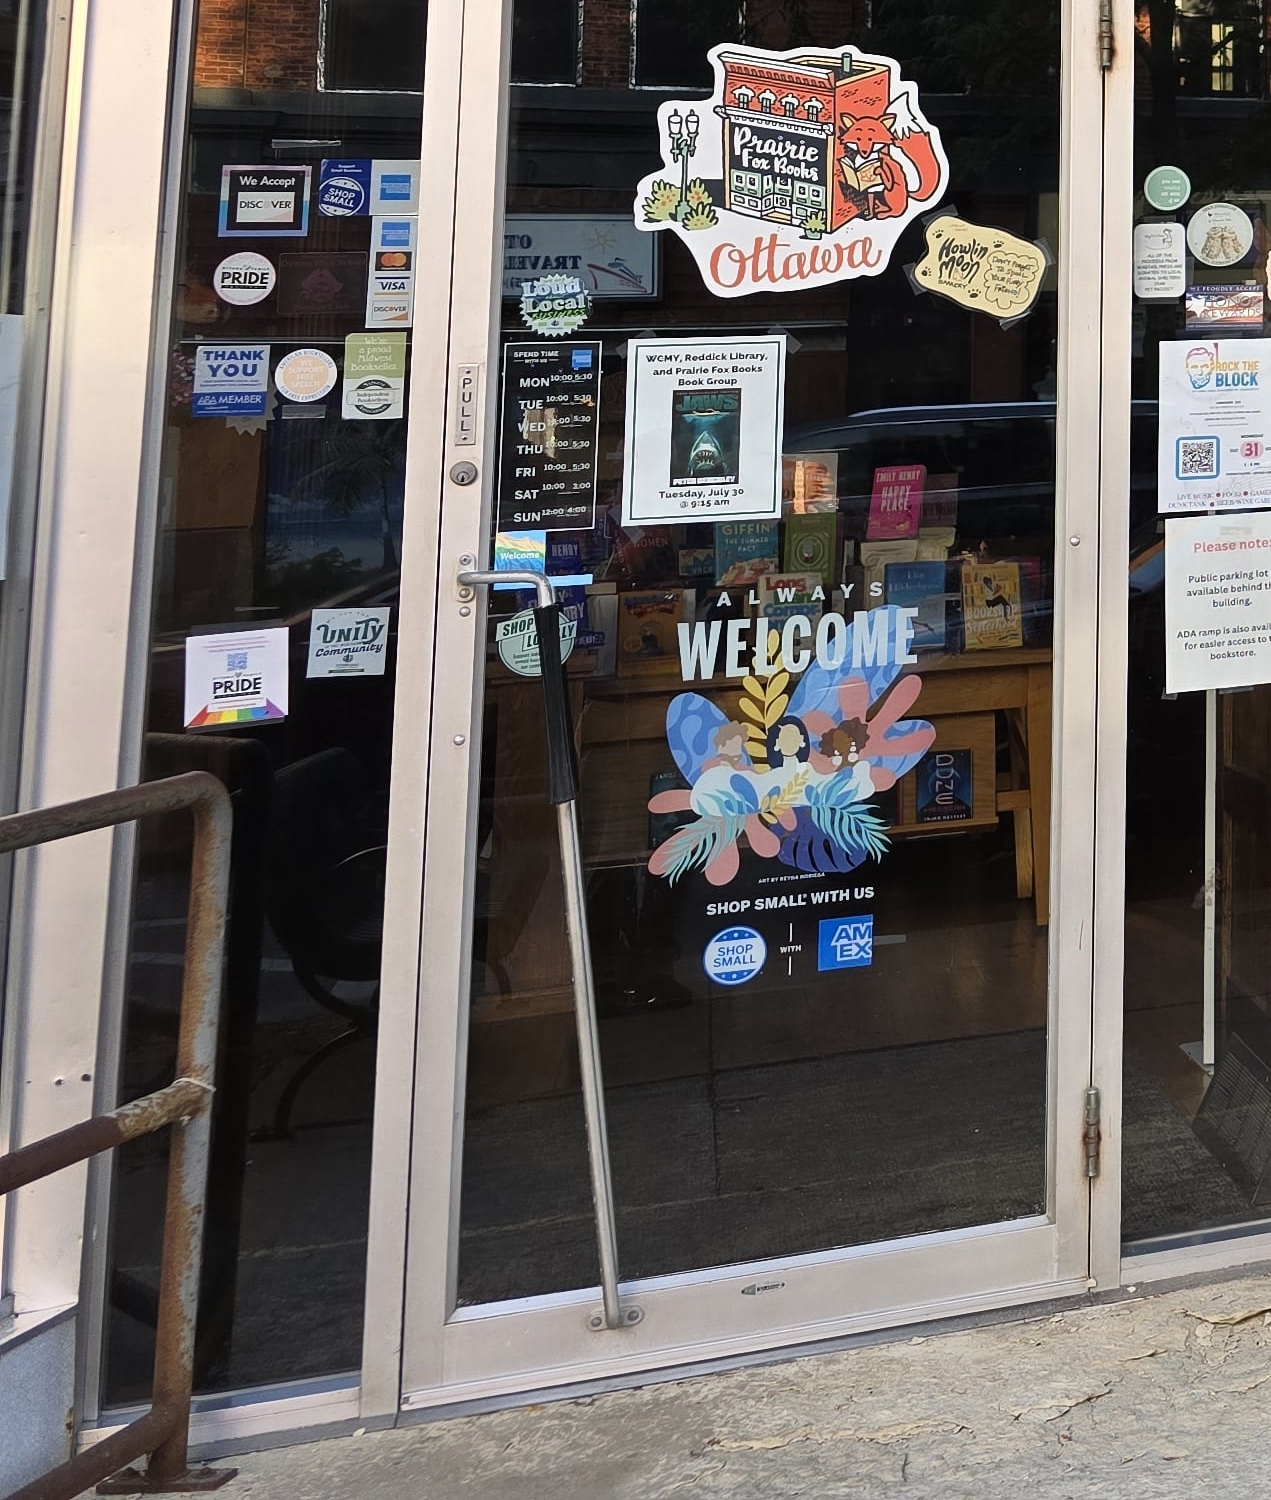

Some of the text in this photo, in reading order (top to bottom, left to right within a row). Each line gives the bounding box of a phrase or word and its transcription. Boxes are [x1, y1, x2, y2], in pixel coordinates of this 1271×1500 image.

[733, 126, 819, 162] Prairie
[742, 148, 819, 182] Fox Books
[240, 176, 296, 188] We Accept
[328, 187, 355, 199] SHOP
[324, 195, 355, 208] SMALL
[938, 237, 989, 262] Howlin
[710, 233, 882, 288] Ottawa
[938, 255, 980, 284] Moon
[221, 272, 269, 285] PRIDE
[379, 281, 406, 291] VISA
[521, 278, 581, 298] Loud
[523, 294, 586, 315] Local
[531, 308, 586, 321] BUSINESS
[1203, 308, 1262, 318] REWARDS
[203, 350, 264, 361] THANK
[357, 354, 392, 363] Midwest
[646, 352, 768, 363] WCMY, Reddick Library,
[208, 364, 257, 378] YOU
[351, 363, 398, 371] Bookseller
[653, 365, 763, 376] and Prairie Fox Books
[1216, 361, 1260, 372] ROCK THE
[519, 378, 550, 388] MON
[678, 377, 737, 387] Book Group
[1216, 371, 1259, 387] BLOCK
[218, 395, 262, 405] MEMBER
[460, 376, 472, 432] PULL
[519, 400, 544, 410] TUE
[675, 394, 739, 412] JAWS
[518, 422, 546, 433] WED
[517, 445, 543, 454] THU
[1245, 442, 1260, 457] 31
[515, 466, 536, 477] FRI
[876, 470, 921, 483] EMILY HENRY
[514, 490, 539, 500] SAT
[659, 488, 744, 499] Tuesday, July 30
[882, 485, 911, 498] HAPPY
[691, 500, 711, 508] 9:15
[880, 499, 910, 513] PLACE
[513, 511, 541, 522] SUN
[722, 524, 770, 535] GIFFIN
[552, 543, 578, 557] HENRY
[1193, 542, 1236, 553] Please
[500, 551, 540, 560] Welcome
[1188, 573, 1218, 583] Public
[1220, 570, 1254, 582] parking
[1256, 569, 1268, 577] lot
[716, 582, 883, 608] ALWAYS
[1187, 588, 1228, 596] available
[1230, 584, 1262, 593] behind
[1213, 598, 1252, 608] building.
[502, 619, 533, 637] SHOP
[1177, 630, 1196, 638] ADA
[1199, 629, 1221, 638] ramp
[1232, 625, 1249, 634] also
[315, 642, 384, 658] Community
[677, 607, 919, 682] WELCOME
[1184, 642, 1197, 650] for
[1199, 640, 1225, 649] easier
[1227, 638, 1256, 646] access
[1210, 650, 1257, 660] bookstore.
[212, 677, 262, 695] PRIDE
[706, 900, 751, 916] SHOP
[811, 889, 850, 904] WITH
[854, 886, 875, 899] US
[832, 922, 873, 946] AM
[717, 944, 753, 957] SHOP
[780, 945, 802, 954] WITH
[837, 941, 872, 961] EX
[713, 956, 756, 968] SMALL
